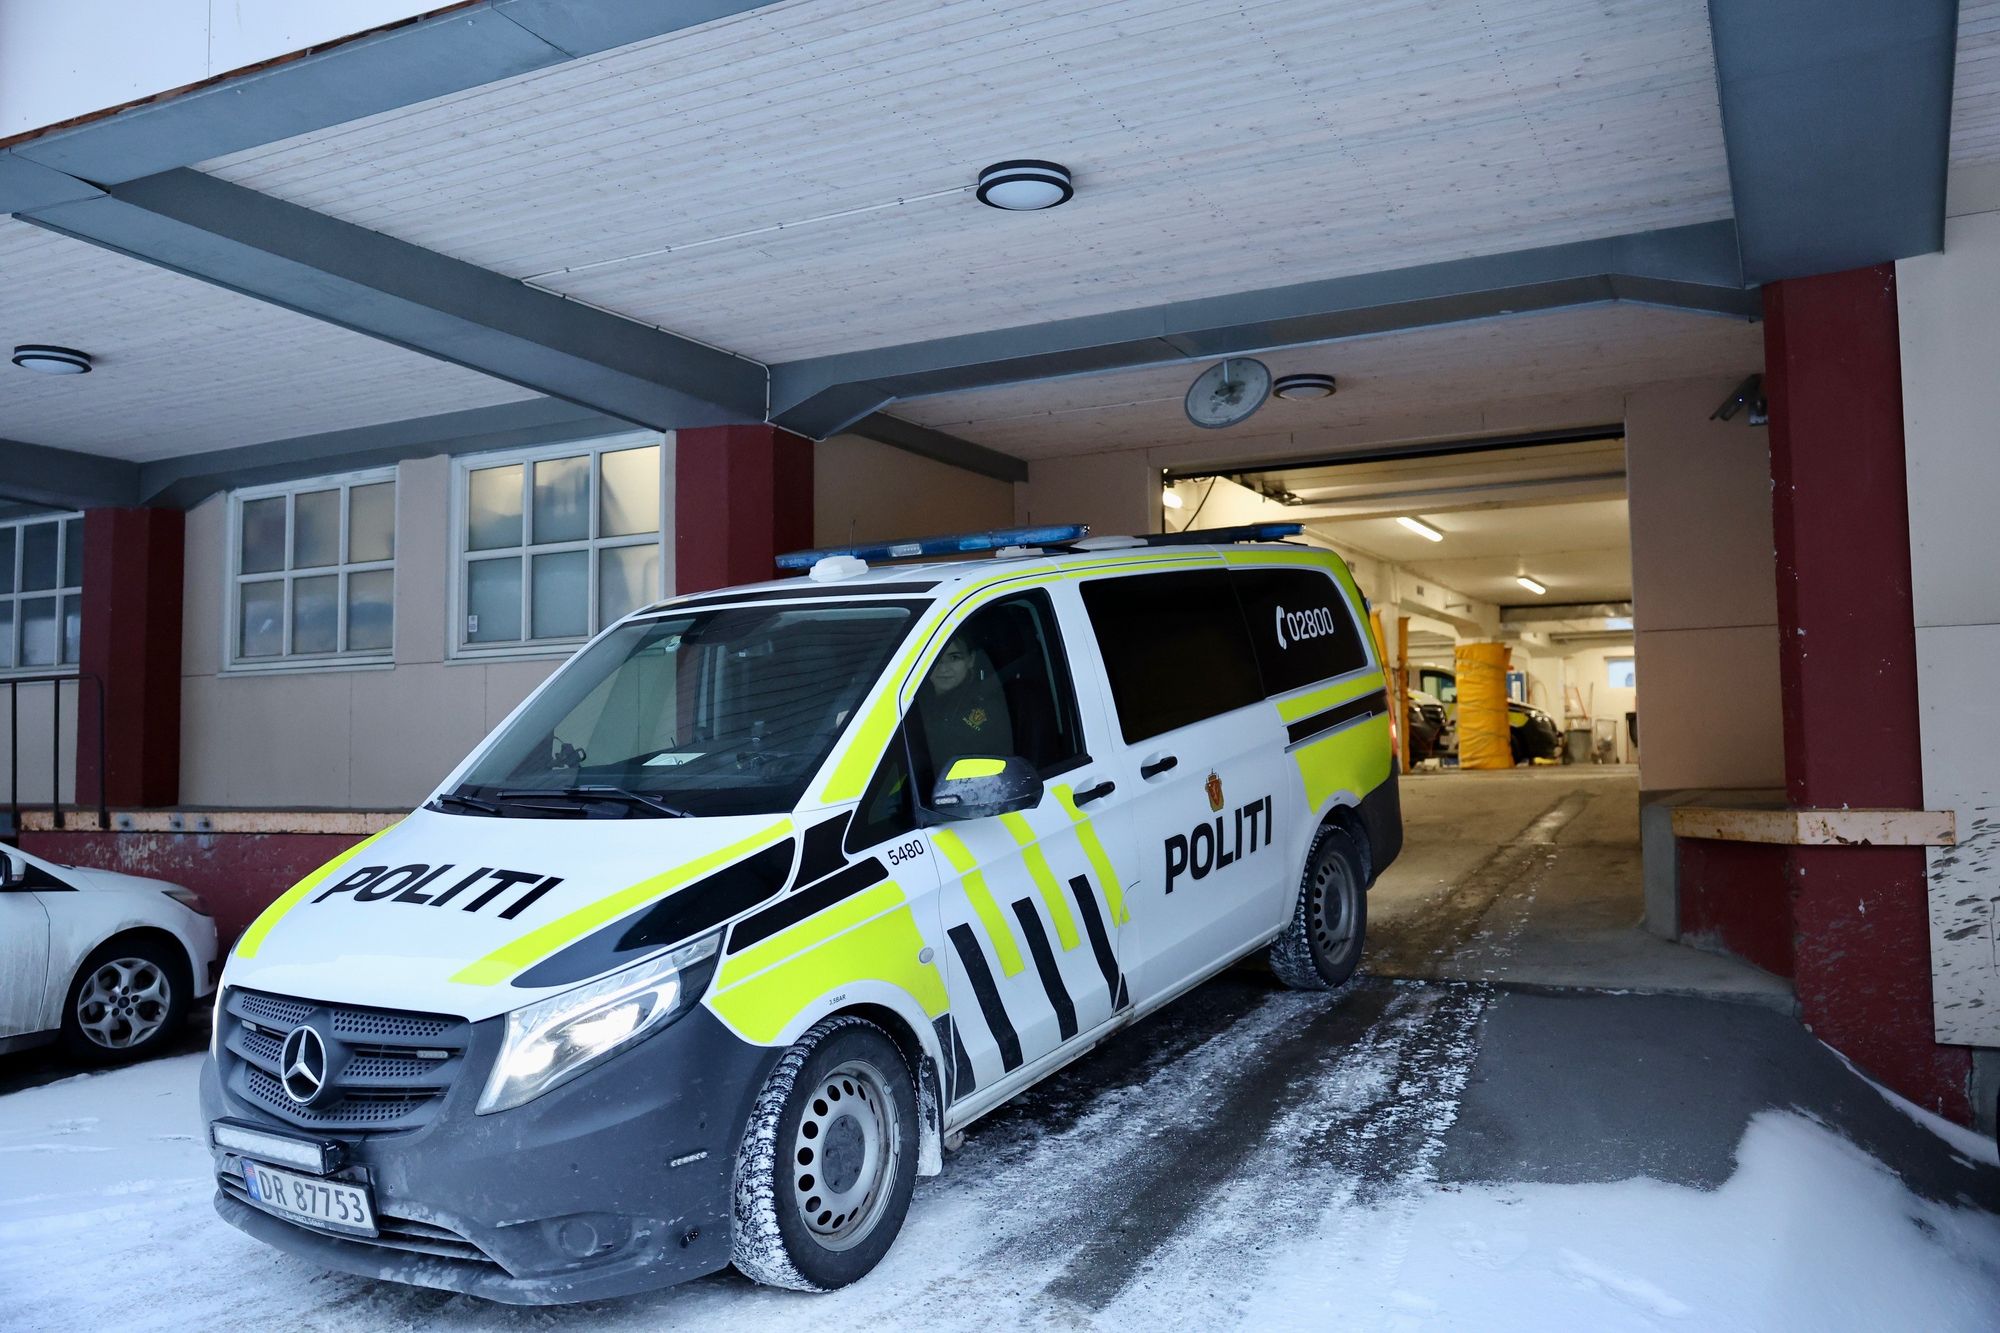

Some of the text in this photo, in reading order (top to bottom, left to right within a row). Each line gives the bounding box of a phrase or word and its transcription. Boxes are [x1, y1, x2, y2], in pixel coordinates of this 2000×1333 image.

[1286, 606, 1335, 642] 02800
[888, 839, 924, 866] 5480
[1164, 794, 1272, 895] POLITI
[310, 863, 565, 921] POLITI
[258, 1170, 288, 1206] DR
[293, 1180, 365, 1223] 87753
